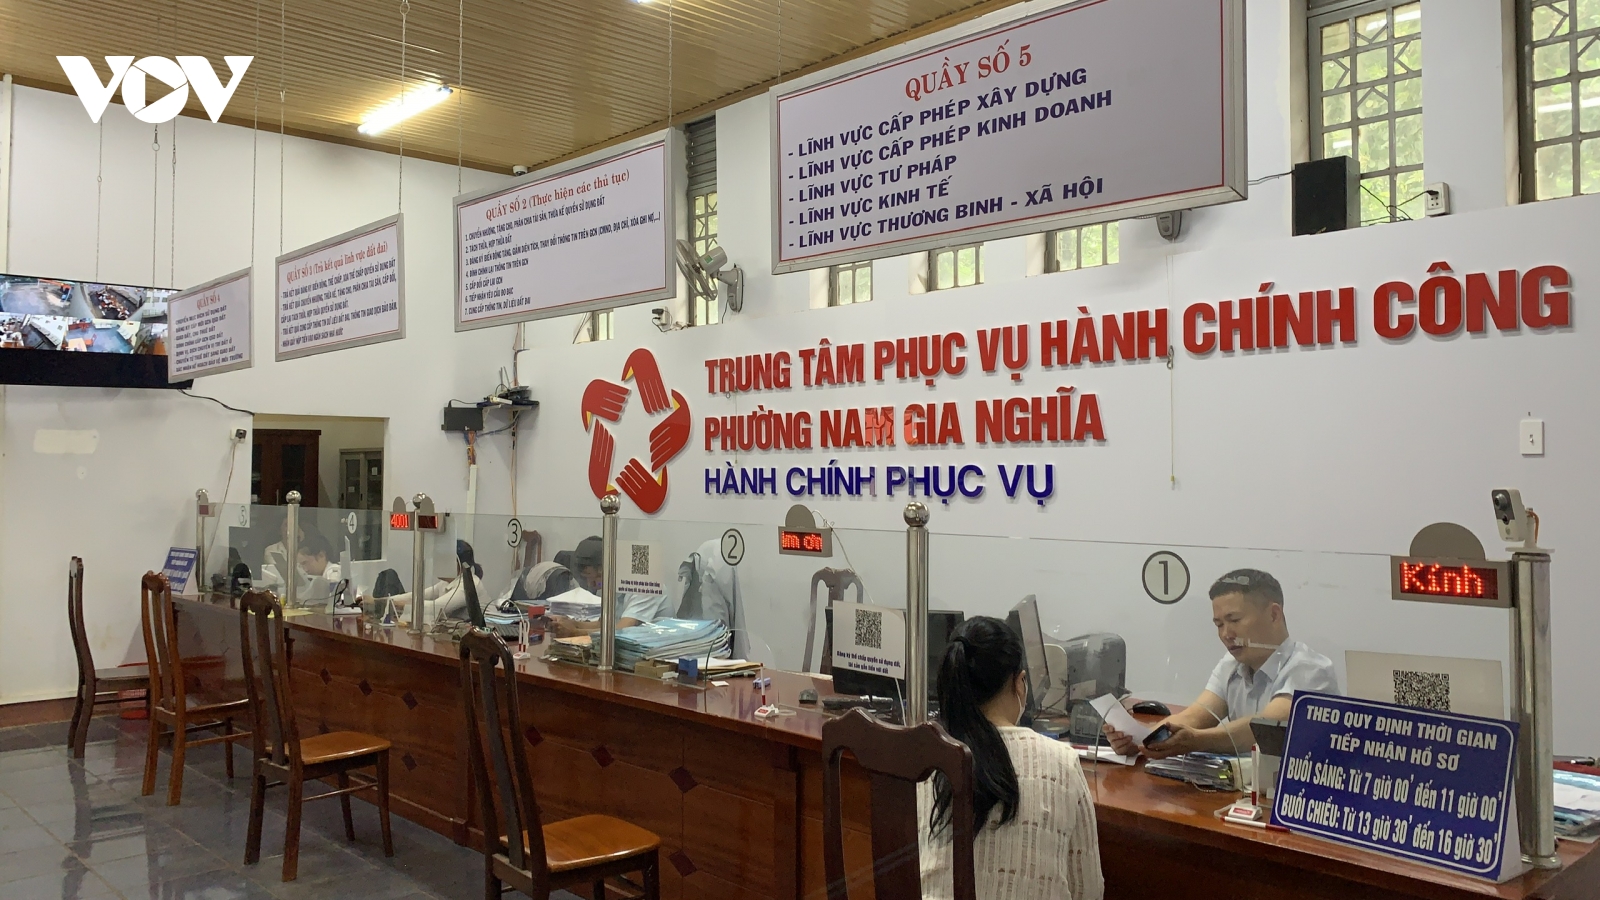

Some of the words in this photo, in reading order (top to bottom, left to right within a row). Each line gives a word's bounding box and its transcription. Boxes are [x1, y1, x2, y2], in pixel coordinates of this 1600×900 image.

[905, 56, 970, 102] QUẦY
[977, 38, 1010, 79] SỐ
[1018, 43, 1031, 67] 5
[798, 135, 834, 157] LĨNH
[839, 124, 873, 146] VỰC
[878, 111, 914, 136] CẤP
[919, 98, 970, 126] PHÉP
[976, 85, 1017, 111] XÂY
[1025, 67, 1087, 98] DỰNG
[799, 159, 834, 180] LĨNH
[839, 149, 873, 170] VỰC
[878, 137, 914, 161] CẤP
[919, 124, 970, 151] PHÉP
[977, 110, 1026, 137] KINH
[1034, 89, 1112, 123] DOANH
[485, 199, 507, 222] QUẦY
[509, 194, 520, 213] SỐ
[521, 198, 527, 210] 2
[528, 192, 552, 208] (Thực
[553, 186, 574, 200] hiện
[576, 181, 591, 195] các
[593, 173, 609, 190] thủ
[611, 168, 630, 186] tục)
[799, 182, 835, 202] LĨNH
[840, 173, 873, 193] VỰC
[878, 164, 903, 185] TƯ
[907, 154, 957, 179] PHÁP
[799, 206, 834, 225] LĨNH
[839, 197, 873, 217] VỰC
[878, 187, 920, 210] KINH
[926, 174, 952, 199] TẾ
[799, 229, 834, 248] LĨNH
[839, 221, 872, 241] VỰC
[876, 207, 949, 234] THƯƠNG
[955, 196, 1003, 219] BINH
[1024, 183, 1053, 207] XÃ
[1062, 175, 1103, 200] HỘI
[704, 350, 792, 394] TRUNG
[799, 337, 865, 387] TÂM
[874, 331, 967, 387] PHỤC
[976, 324, 1029, 381] VỤ
[1040, 306, 1168, 367] HÀNH
[1182, 281, 1357, 355] CHÍNH
[1373, 260, 1571, 339] CÔNG
[704, 404, 811, 452] PHƯỜNG
[820, 405, 895, 449] NAM
[903, 401, 964, 446] GIA
[975, 385, 1106, 446] NGHĨA
[704, 460, 777, 497] HÀNH
[785, 458, 877, 497] CHÍNH
[886, 463, 985, 505] PHỤC
[998, 463, 1055, 506] VỤ
[391, 514, 408, 528] 4001
[511, 523, 518, 544] 3
[728, 534, 738, 560] 2
[1158, 560, 1169, 595] 1
[1402, 562, 1482, 595] Kính
[1306, 704, 1340, 724] THEO
[1343, 711, 1373, 729] QUY
[1375, 715, 1413, 736] ĐỊNH
[1417, 722, 1452, 743] THỜI
[1456, 729, 1497, 750] GIAN
[1329, 732, 1360, 753] TIẾP
[1363, 739, 1407, 763] NHẬN
[1409, 745, 1432, 766] HỒ
[1436, 752, 1460, 771] SƠ
[1286, 751, 1313, 783] BUỔI
[1312, 758, 1346, 791] SÁNG:
[1348, 768, 1363, 794] Từ
[1363, 771, 1372, 795] 7
[1372, 774, 1393, 800] giờ
[1414, 779, 1437, 809] đến
[1440, 787, 1454, 813] 11
[1456, 791, 1479, 819] giờ
[1280, 787, 1306, 820] BUỔI
[1306, 795, 1340, 829] CHIỀU:
[1342, 806, 1357, 832] Từ
[1357, 810, 1371, 835] 13
[1371, 814, 1392, 841] giờ
[1412, 820, 1435, 851] đến
[1437, 828, 1453, 855] 16
[1453, 833, 1475, 861] giờ
